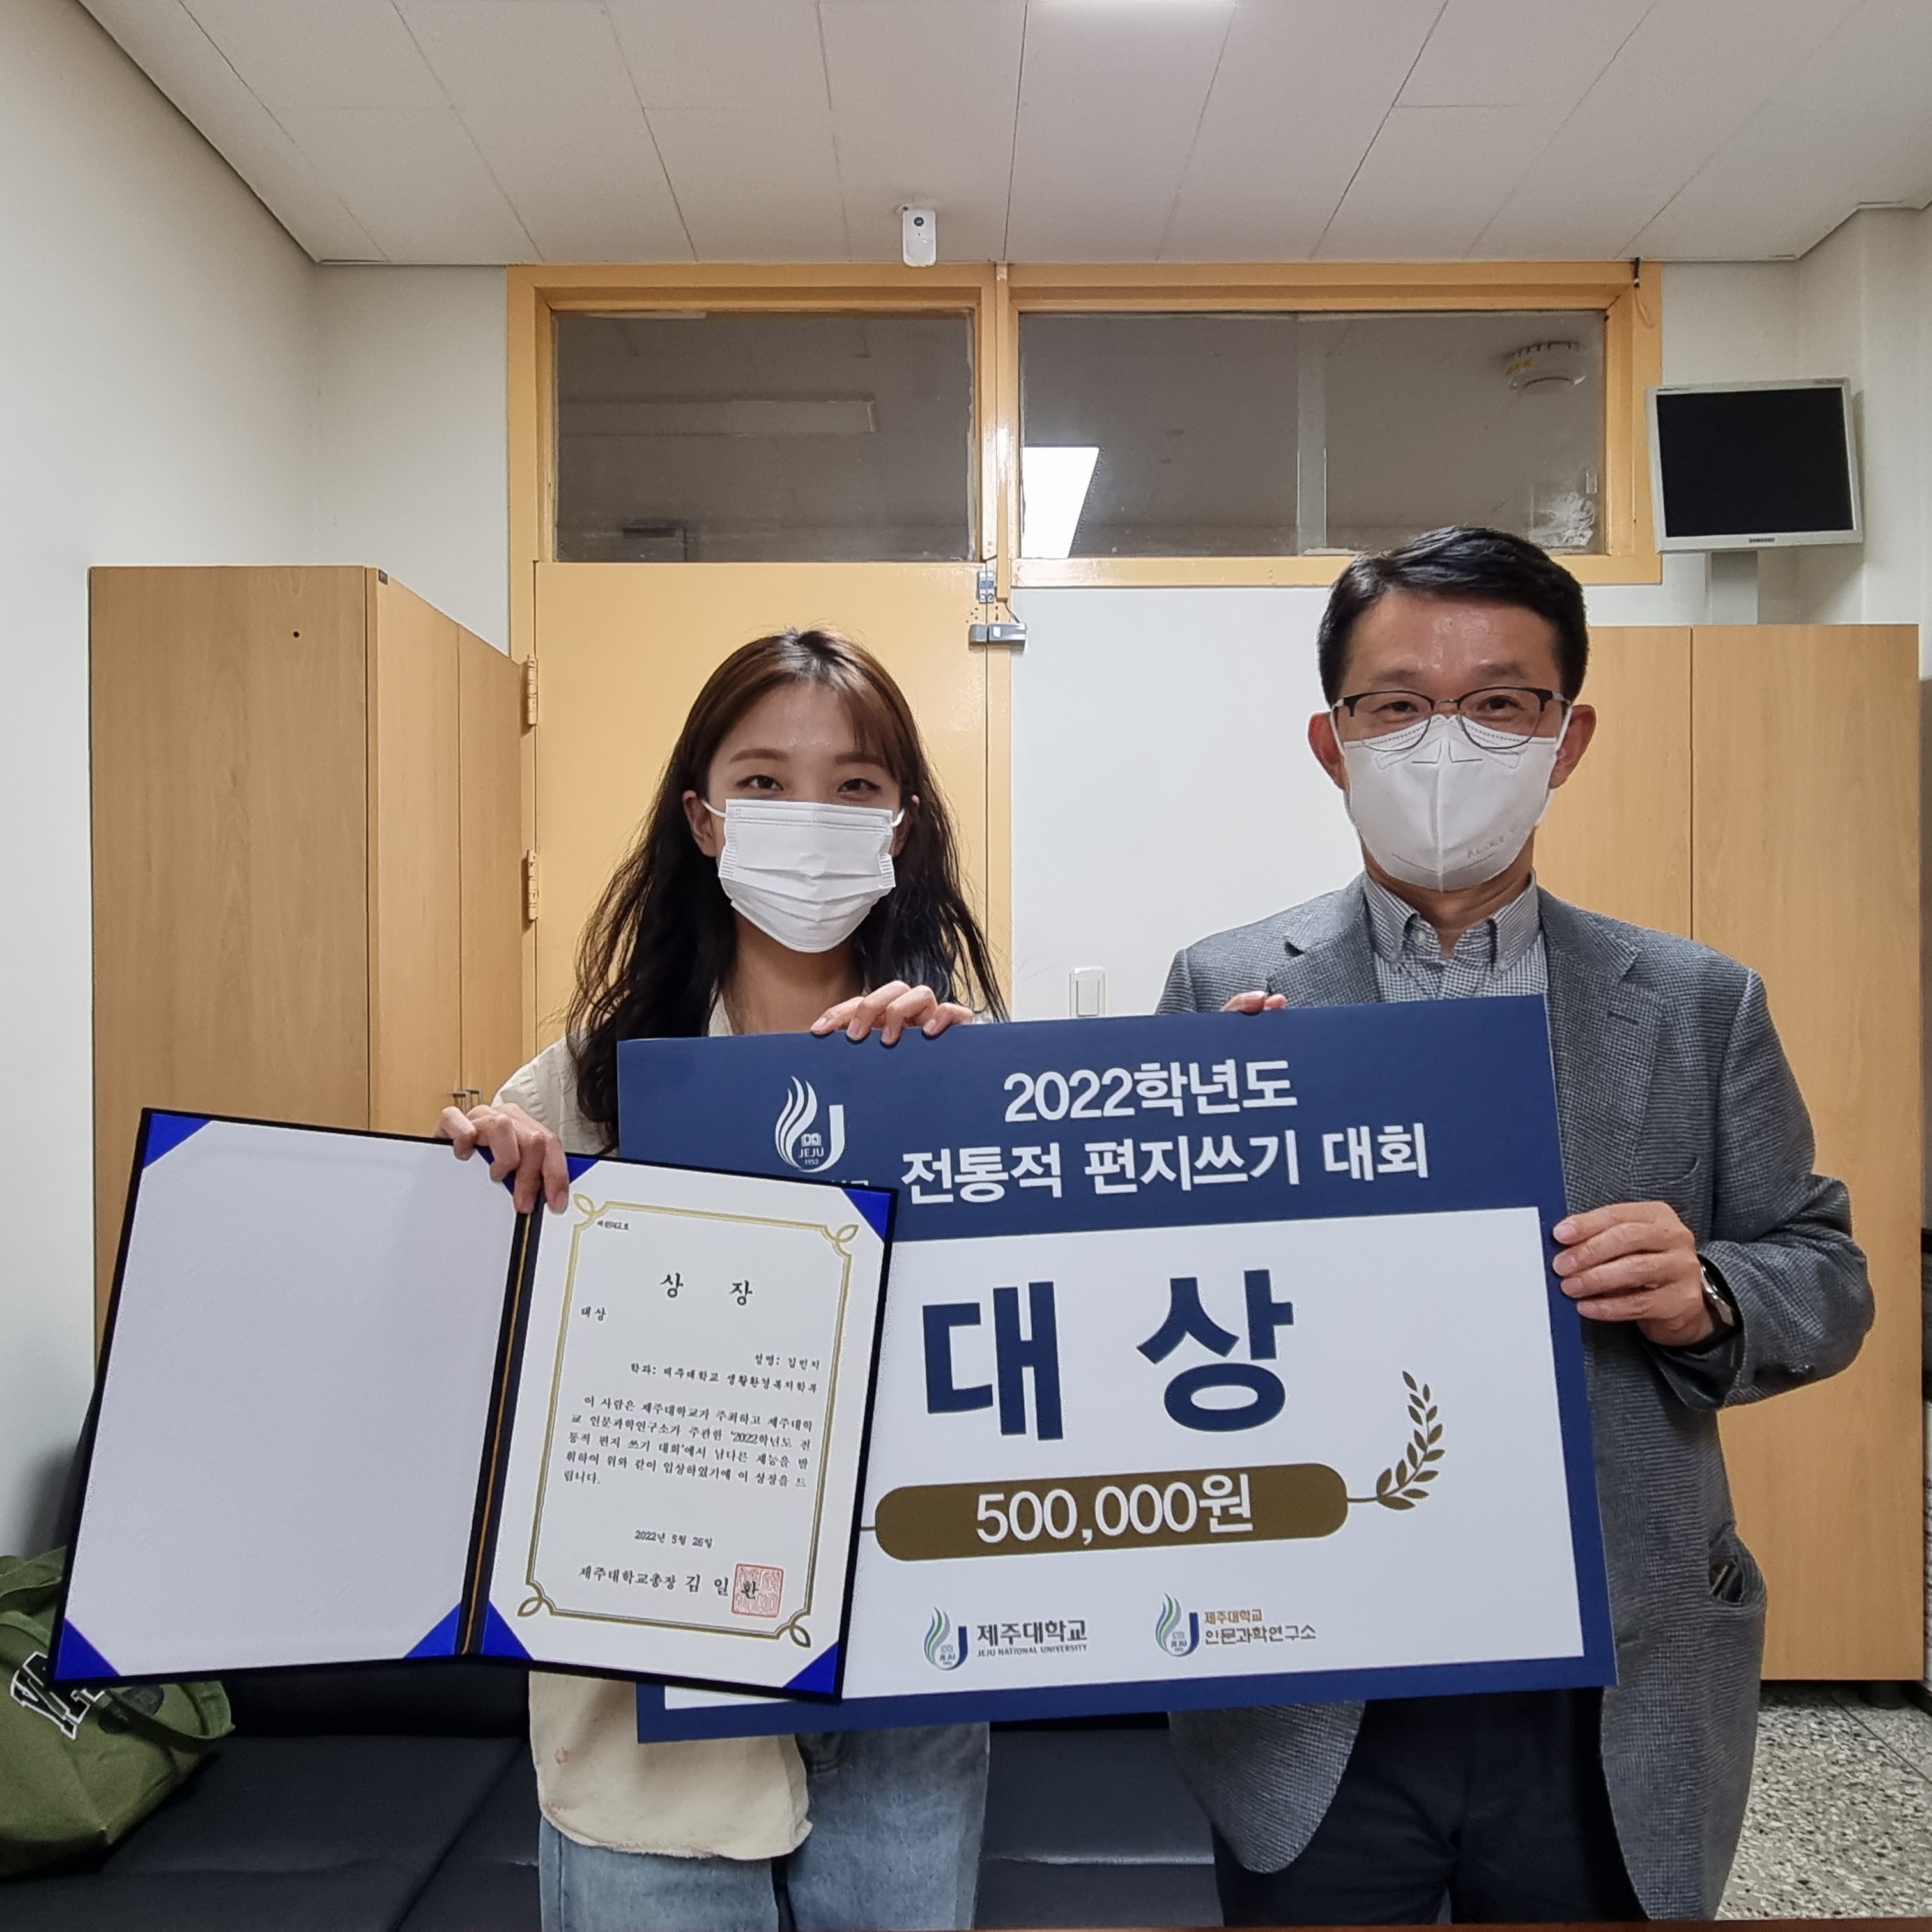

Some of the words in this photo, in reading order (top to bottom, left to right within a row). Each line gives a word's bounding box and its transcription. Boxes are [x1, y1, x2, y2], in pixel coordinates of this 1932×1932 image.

[1004, 1059, 1297, 1122] 2022학년도
[799, 1147, 824, 1158] JEJU
[901, 1142, 1062, 1204] 전통적
[1085, 1130, 1299, 1194] 편지쓰기
[1322, 1123, 1428, 1181] 대회
[581, 1307, 606, 1321] 대상
[664, 1367, 718, 1381] 제주대학교
[585, 1396, 594, 1407] 이
[601, 1398, 634, 1411] 사람은
[642, 1402, 709, 1420] 제주대학교가
[629, 1440, 650, 1452] 쓰기
[738, 1471, 747, 1482] 이
[976, 1473, 1254, 1546] 500,000원
[634, 1530, 665, 1544] 2022년
[672, 1535, 686, 1545] 5월
[579, 1566, 675, 1590] 제주대학교총장
[1205, 1609, 1262, 1625] 제주대학교
[977, 1620, 1087, 1648] 제주대학교
[1206, 1625, 1316, 1644] 인문과학연구소
[978, 1649, 995, 1657] JEJU
[998, 1647, 1037, 1655] NATIONAL
[1041, 1644, 1086, 1653] UNIVERSITY
